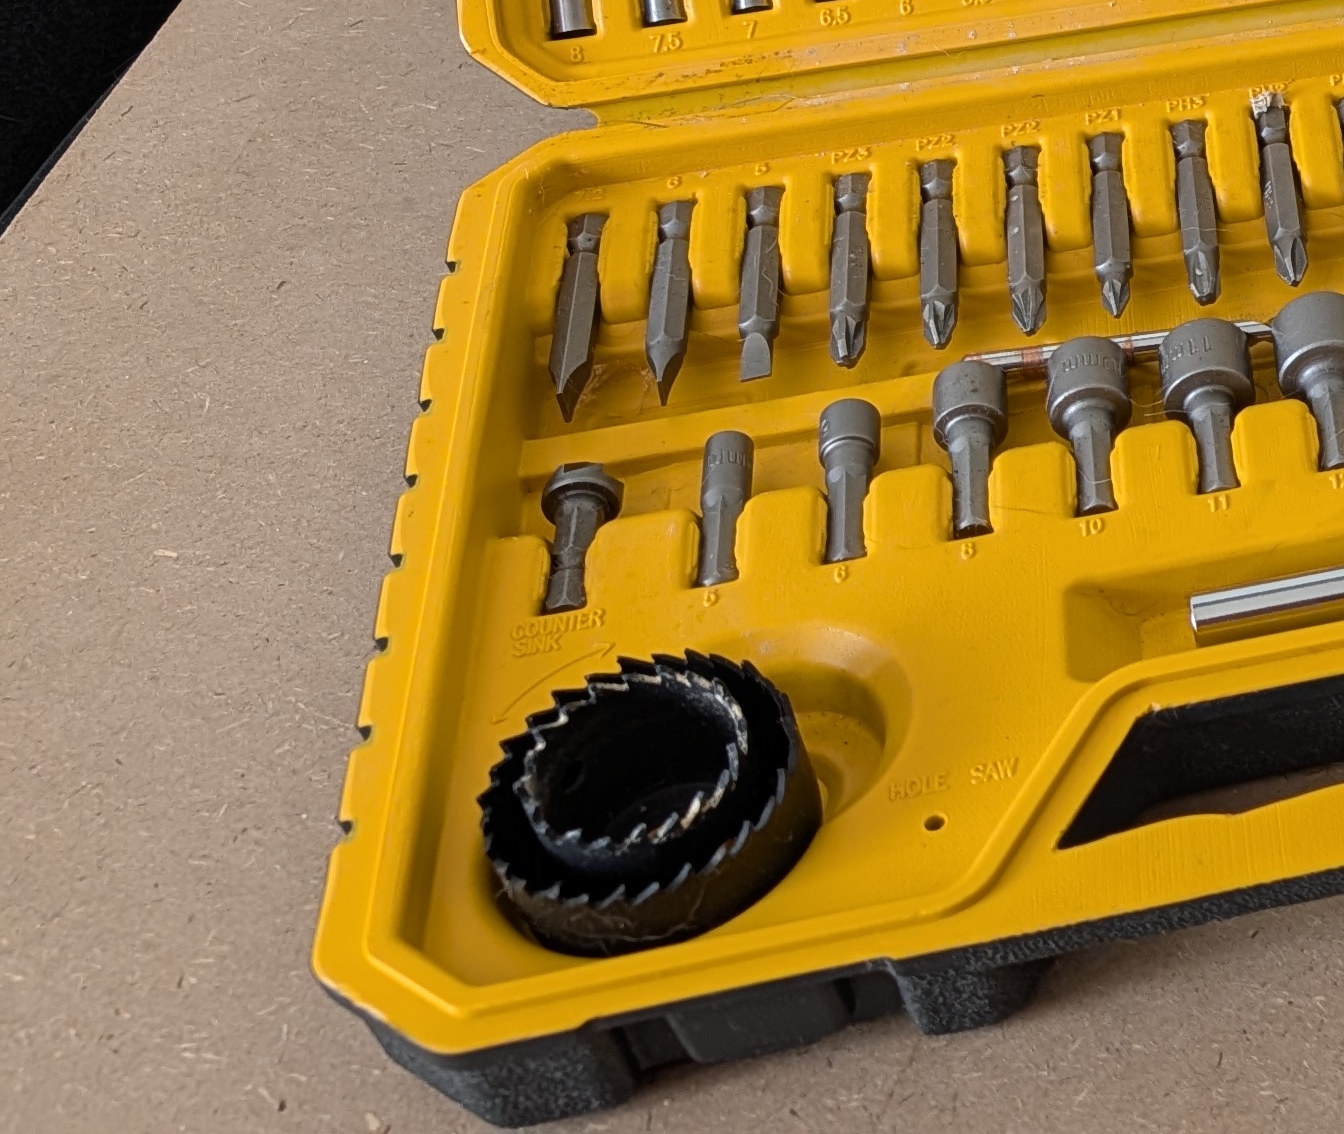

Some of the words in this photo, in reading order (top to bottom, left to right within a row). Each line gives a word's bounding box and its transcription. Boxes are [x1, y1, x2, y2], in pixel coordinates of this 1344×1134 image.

[570, 46, 584, 62] 8
[650, 34, 682, 53] 7.5
[742, 21, 757, 39] 7
[820, 7, 849, 26] 6.5
[916, 134, 955, 151] PZ2
[1001, 121, 1040, 138] PZ2
[1085, 108, 1121, 125] PZ1
[1166, 96, 1205, 113] PH3
[1079, 519, 1103, 536] 10
[1207, 495, 1231, 512] 11
[511, 608, 605, 640] COUNTER
[513, 634, 562, 658] SINK
[889, 772, 949, 801] HOLE
[970, 757, 1019, 785] SAW
